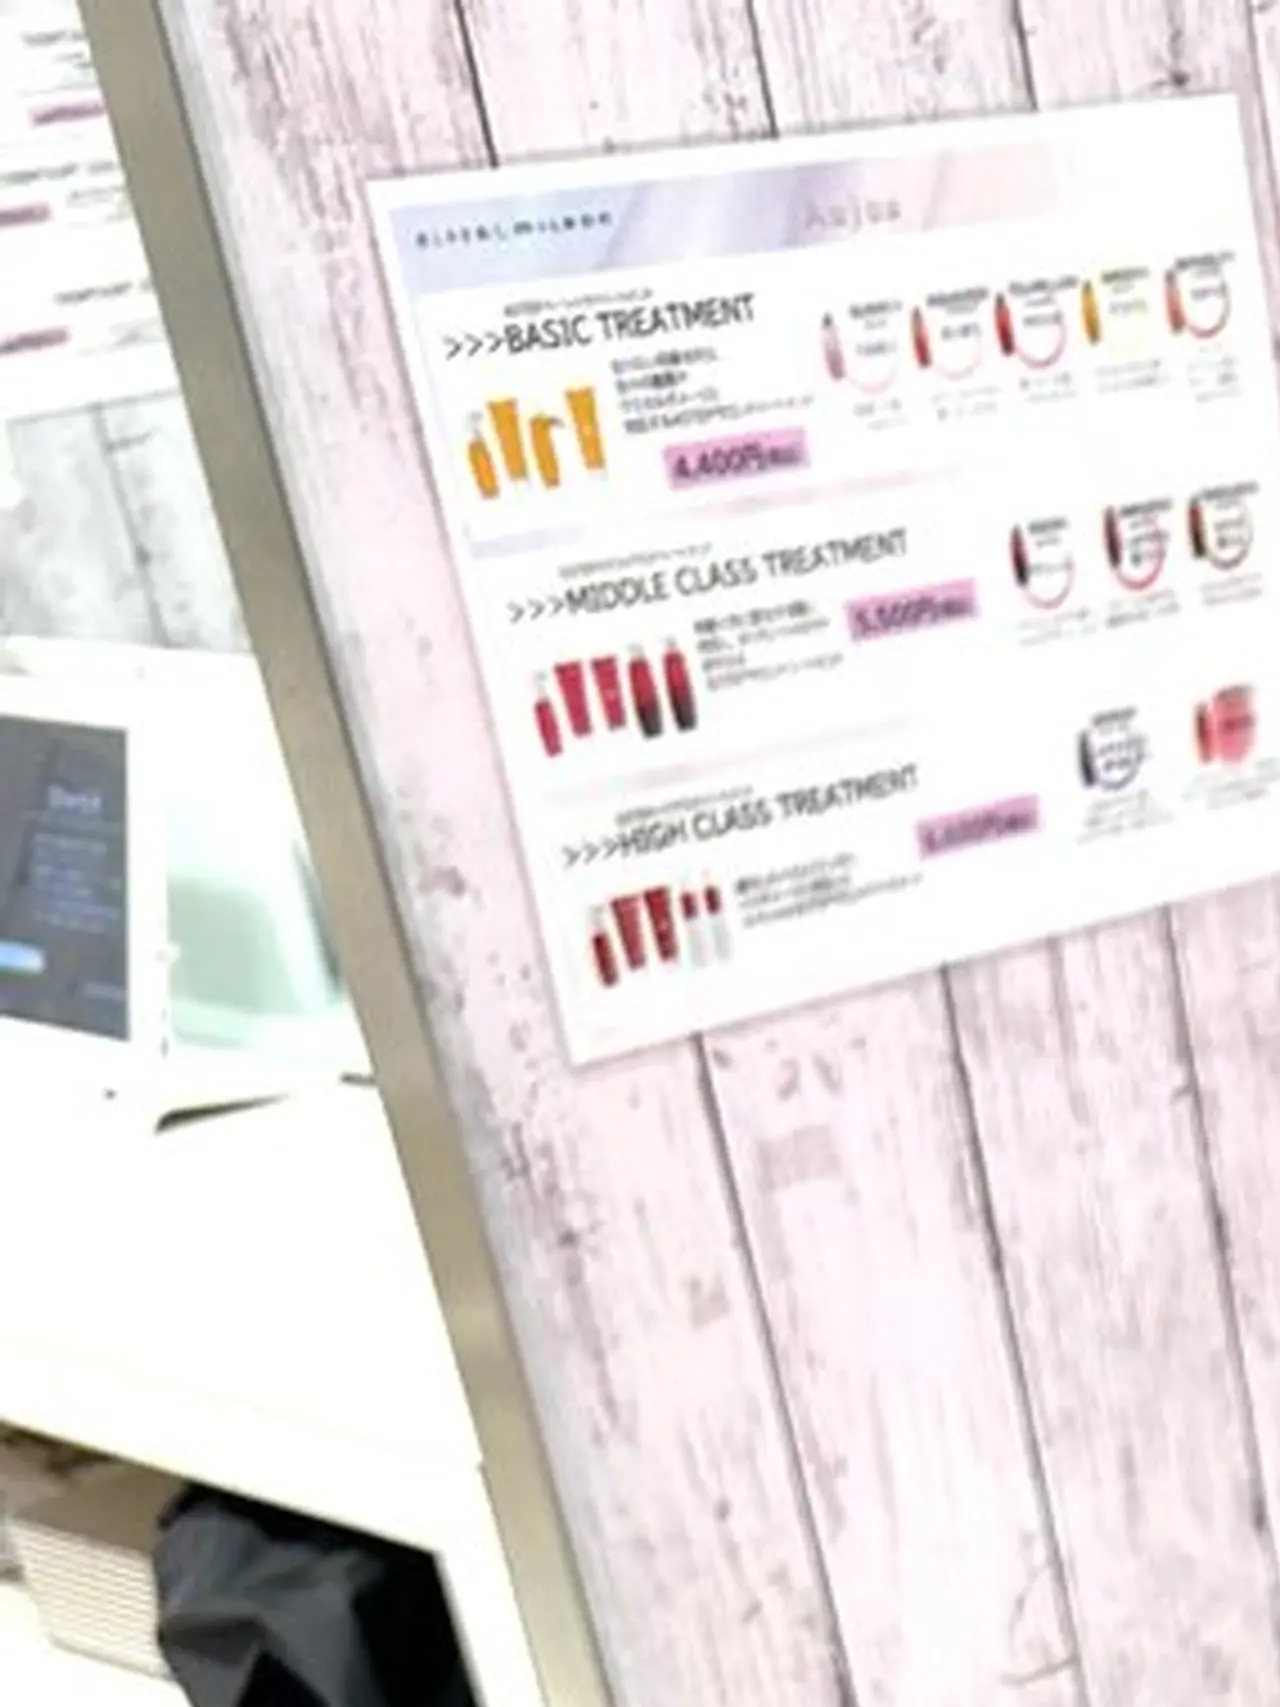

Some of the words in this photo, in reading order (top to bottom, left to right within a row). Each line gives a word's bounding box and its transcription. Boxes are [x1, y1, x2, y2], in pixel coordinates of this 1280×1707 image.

[502, 309, 594, 355] BASIC
[597, 293, 756, 343] TREATMENT
[564, 570, 671, 615] MIDDLE
[674, 555, 760, 598] CLASS
[763, 527, 908, 580] TREATMENT
[618, 817, 687, 857] HIGH
[691, 799, 775, 842] CLASS
[775, 764, 918, 820] TREATMENT
